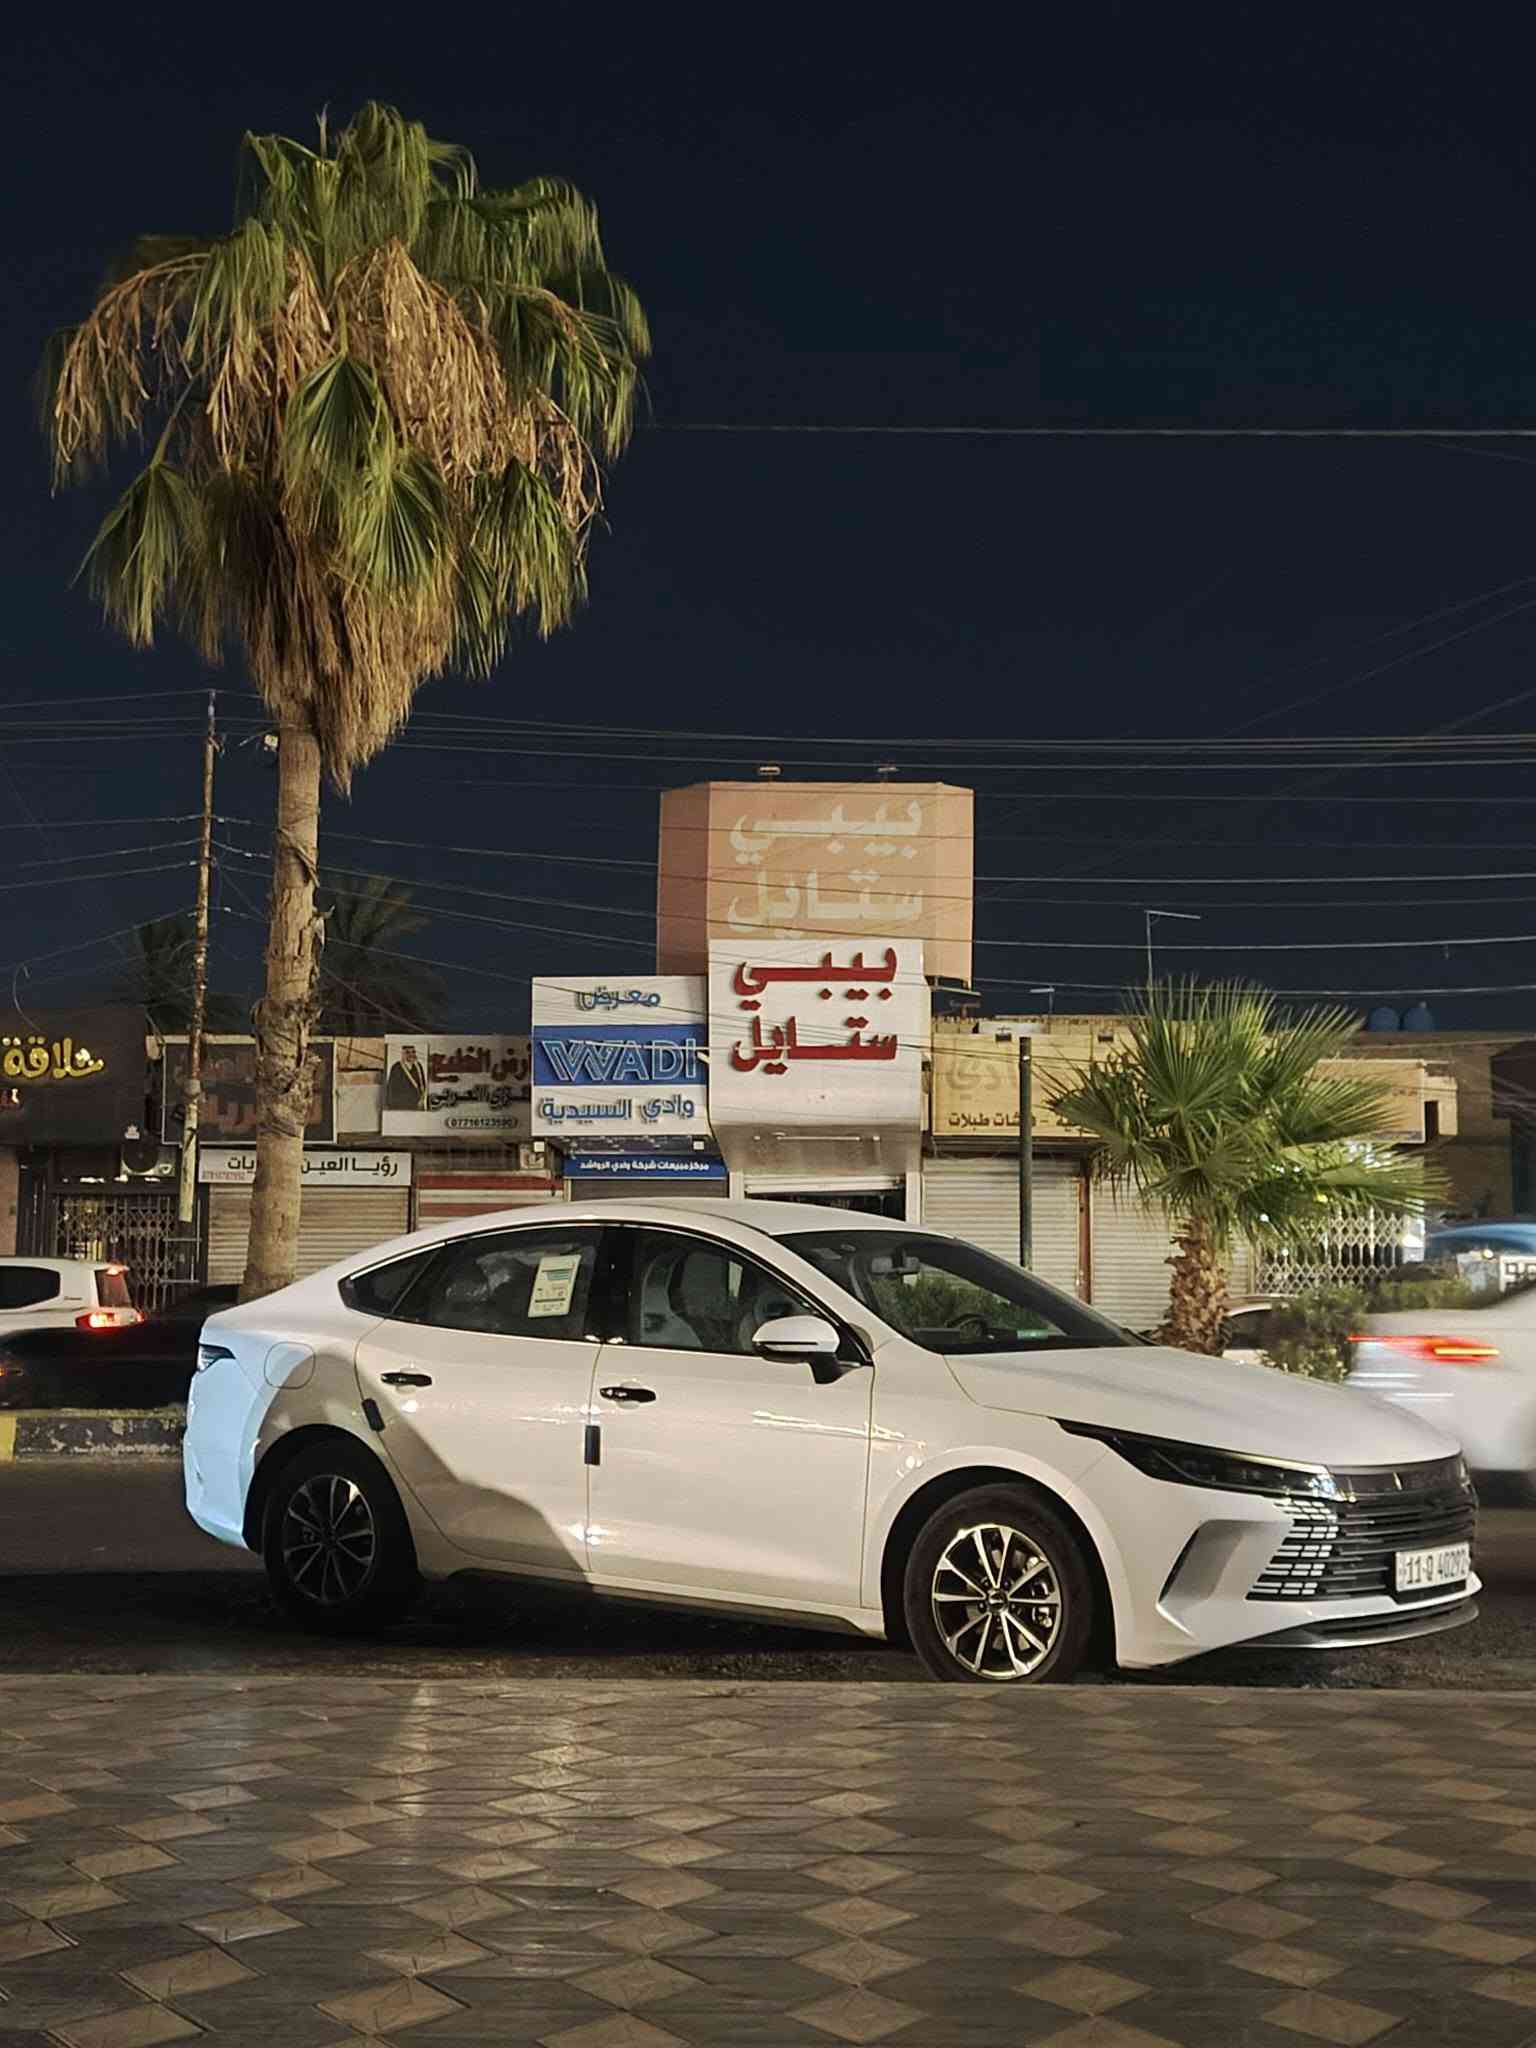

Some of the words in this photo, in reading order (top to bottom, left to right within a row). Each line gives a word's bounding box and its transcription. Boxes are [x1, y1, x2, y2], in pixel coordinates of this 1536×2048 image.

[730, 800, 922, 865] بيبي
[728, 869, 923, 938] ستايل
[734, 947, 897, 1012] بيبي
[576, 985, 661, 1012] معرض
[731, 1015, 897, 1076] ستايل
[430, 1045, 491, 1083] الخليج
[542, 1038, 697, 1082] WADI
[640, 1094, 695, 1124] وادي
[949, 1112, 989, 1130] طبلات
[301, 1156, 349, 1175] العين
[352, 1155, 399, 1177] رؤيا
[611, 1160, 630, 1172] وادي
[632, 1159, 656, 1171] شركة
[657, 1160, 689, 1172] مبيعات
[689, 1160, 710, 1171] مركز
